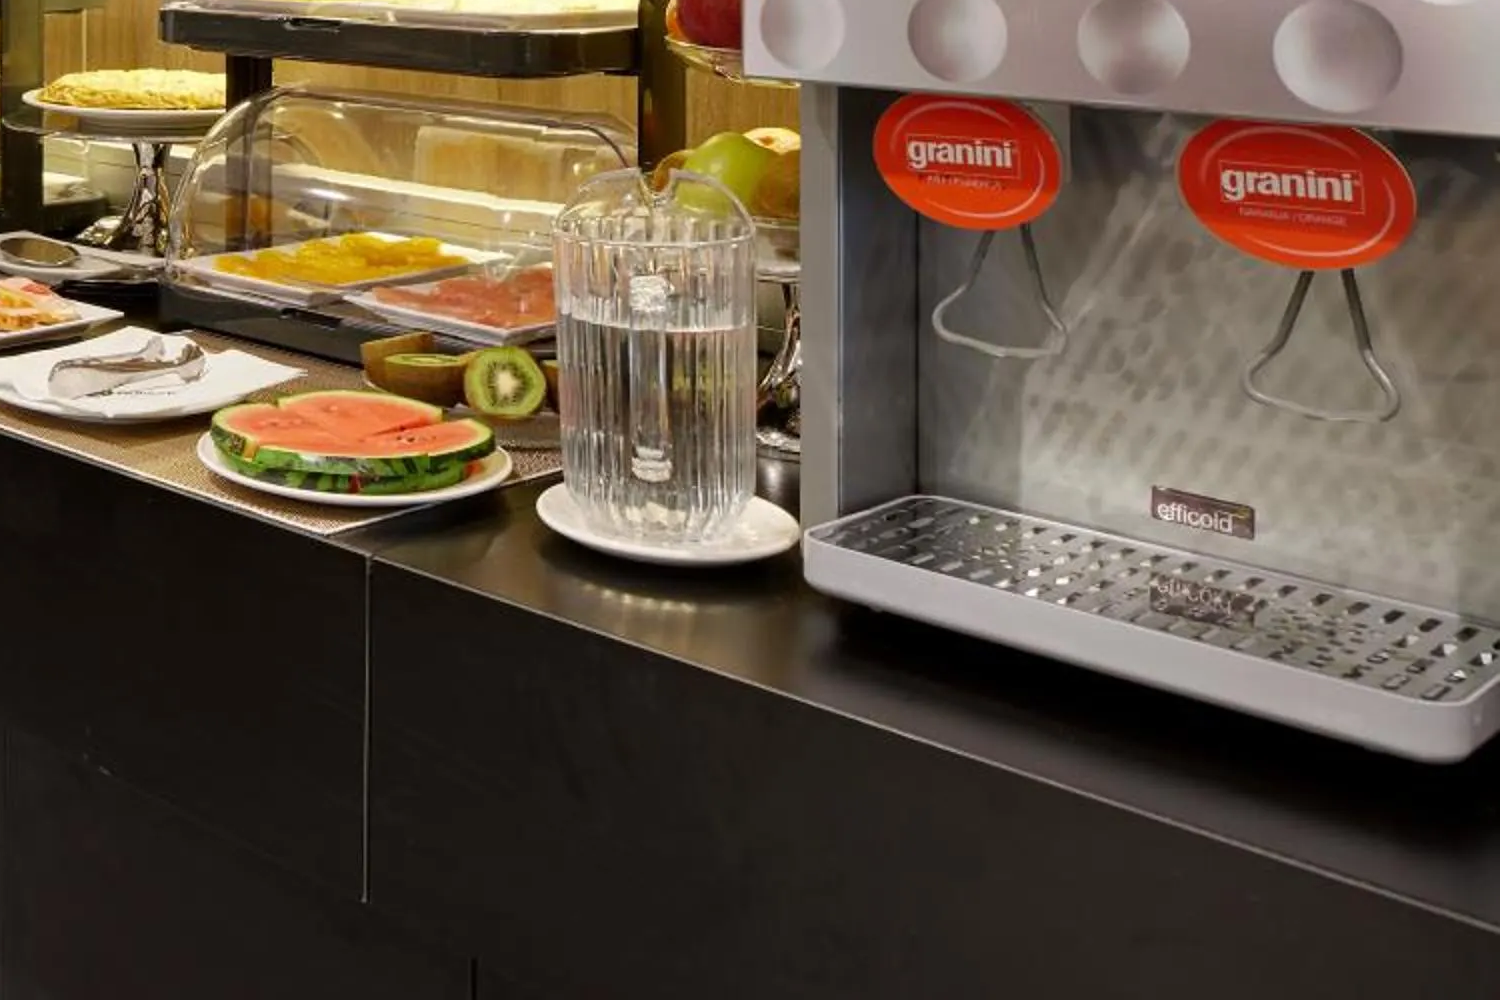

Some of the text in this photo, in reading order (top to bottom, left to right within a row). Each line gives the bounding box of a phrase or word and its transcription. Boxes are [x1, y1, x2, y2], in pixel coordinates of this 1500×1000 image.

[908, 140, 1013, 170] granini
[1221, 168, 1354, 202] granini
[1157, 501, 1233, 534] efficold
